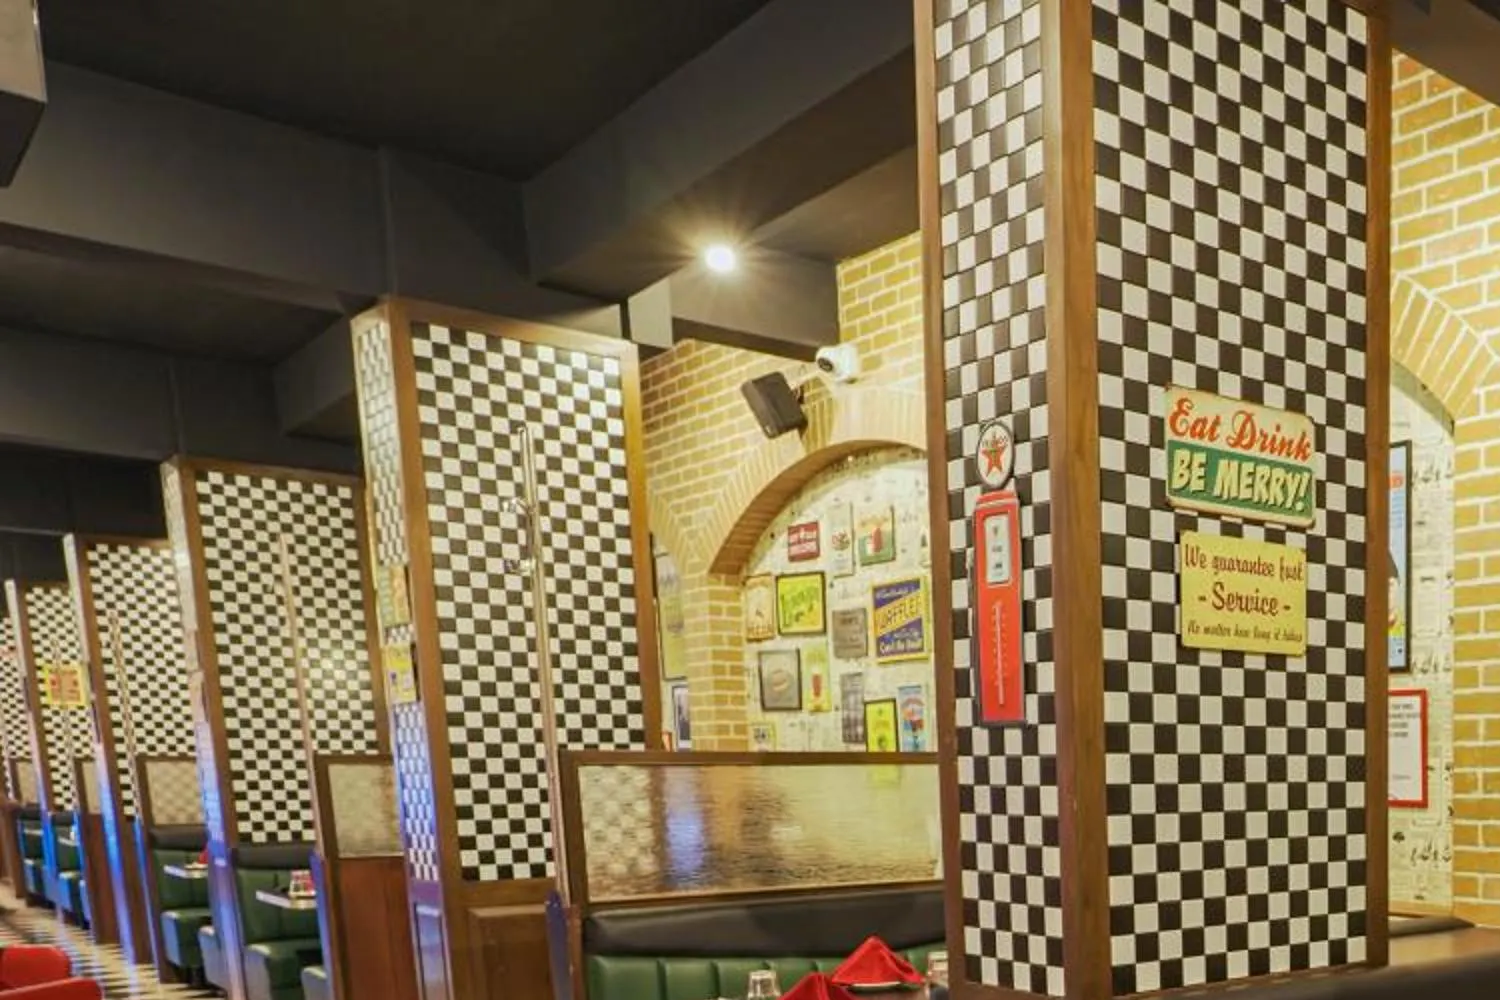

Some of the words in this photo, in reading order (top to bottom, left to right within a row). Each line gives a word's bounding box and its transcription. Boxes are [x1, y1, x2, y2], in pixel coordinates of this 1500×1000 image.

[1169, 396, 1222, 443] Eat
[1226, 410, 1312, 462] Drink
[1171, 448, 1207, 494] BE
[1212, 457, 1311, 512] MERRY!
[1185, 543, 1207, 569] We
[1211, 554, 1275, 578] guarantee
[1211, 581, 1279, 617] Service
